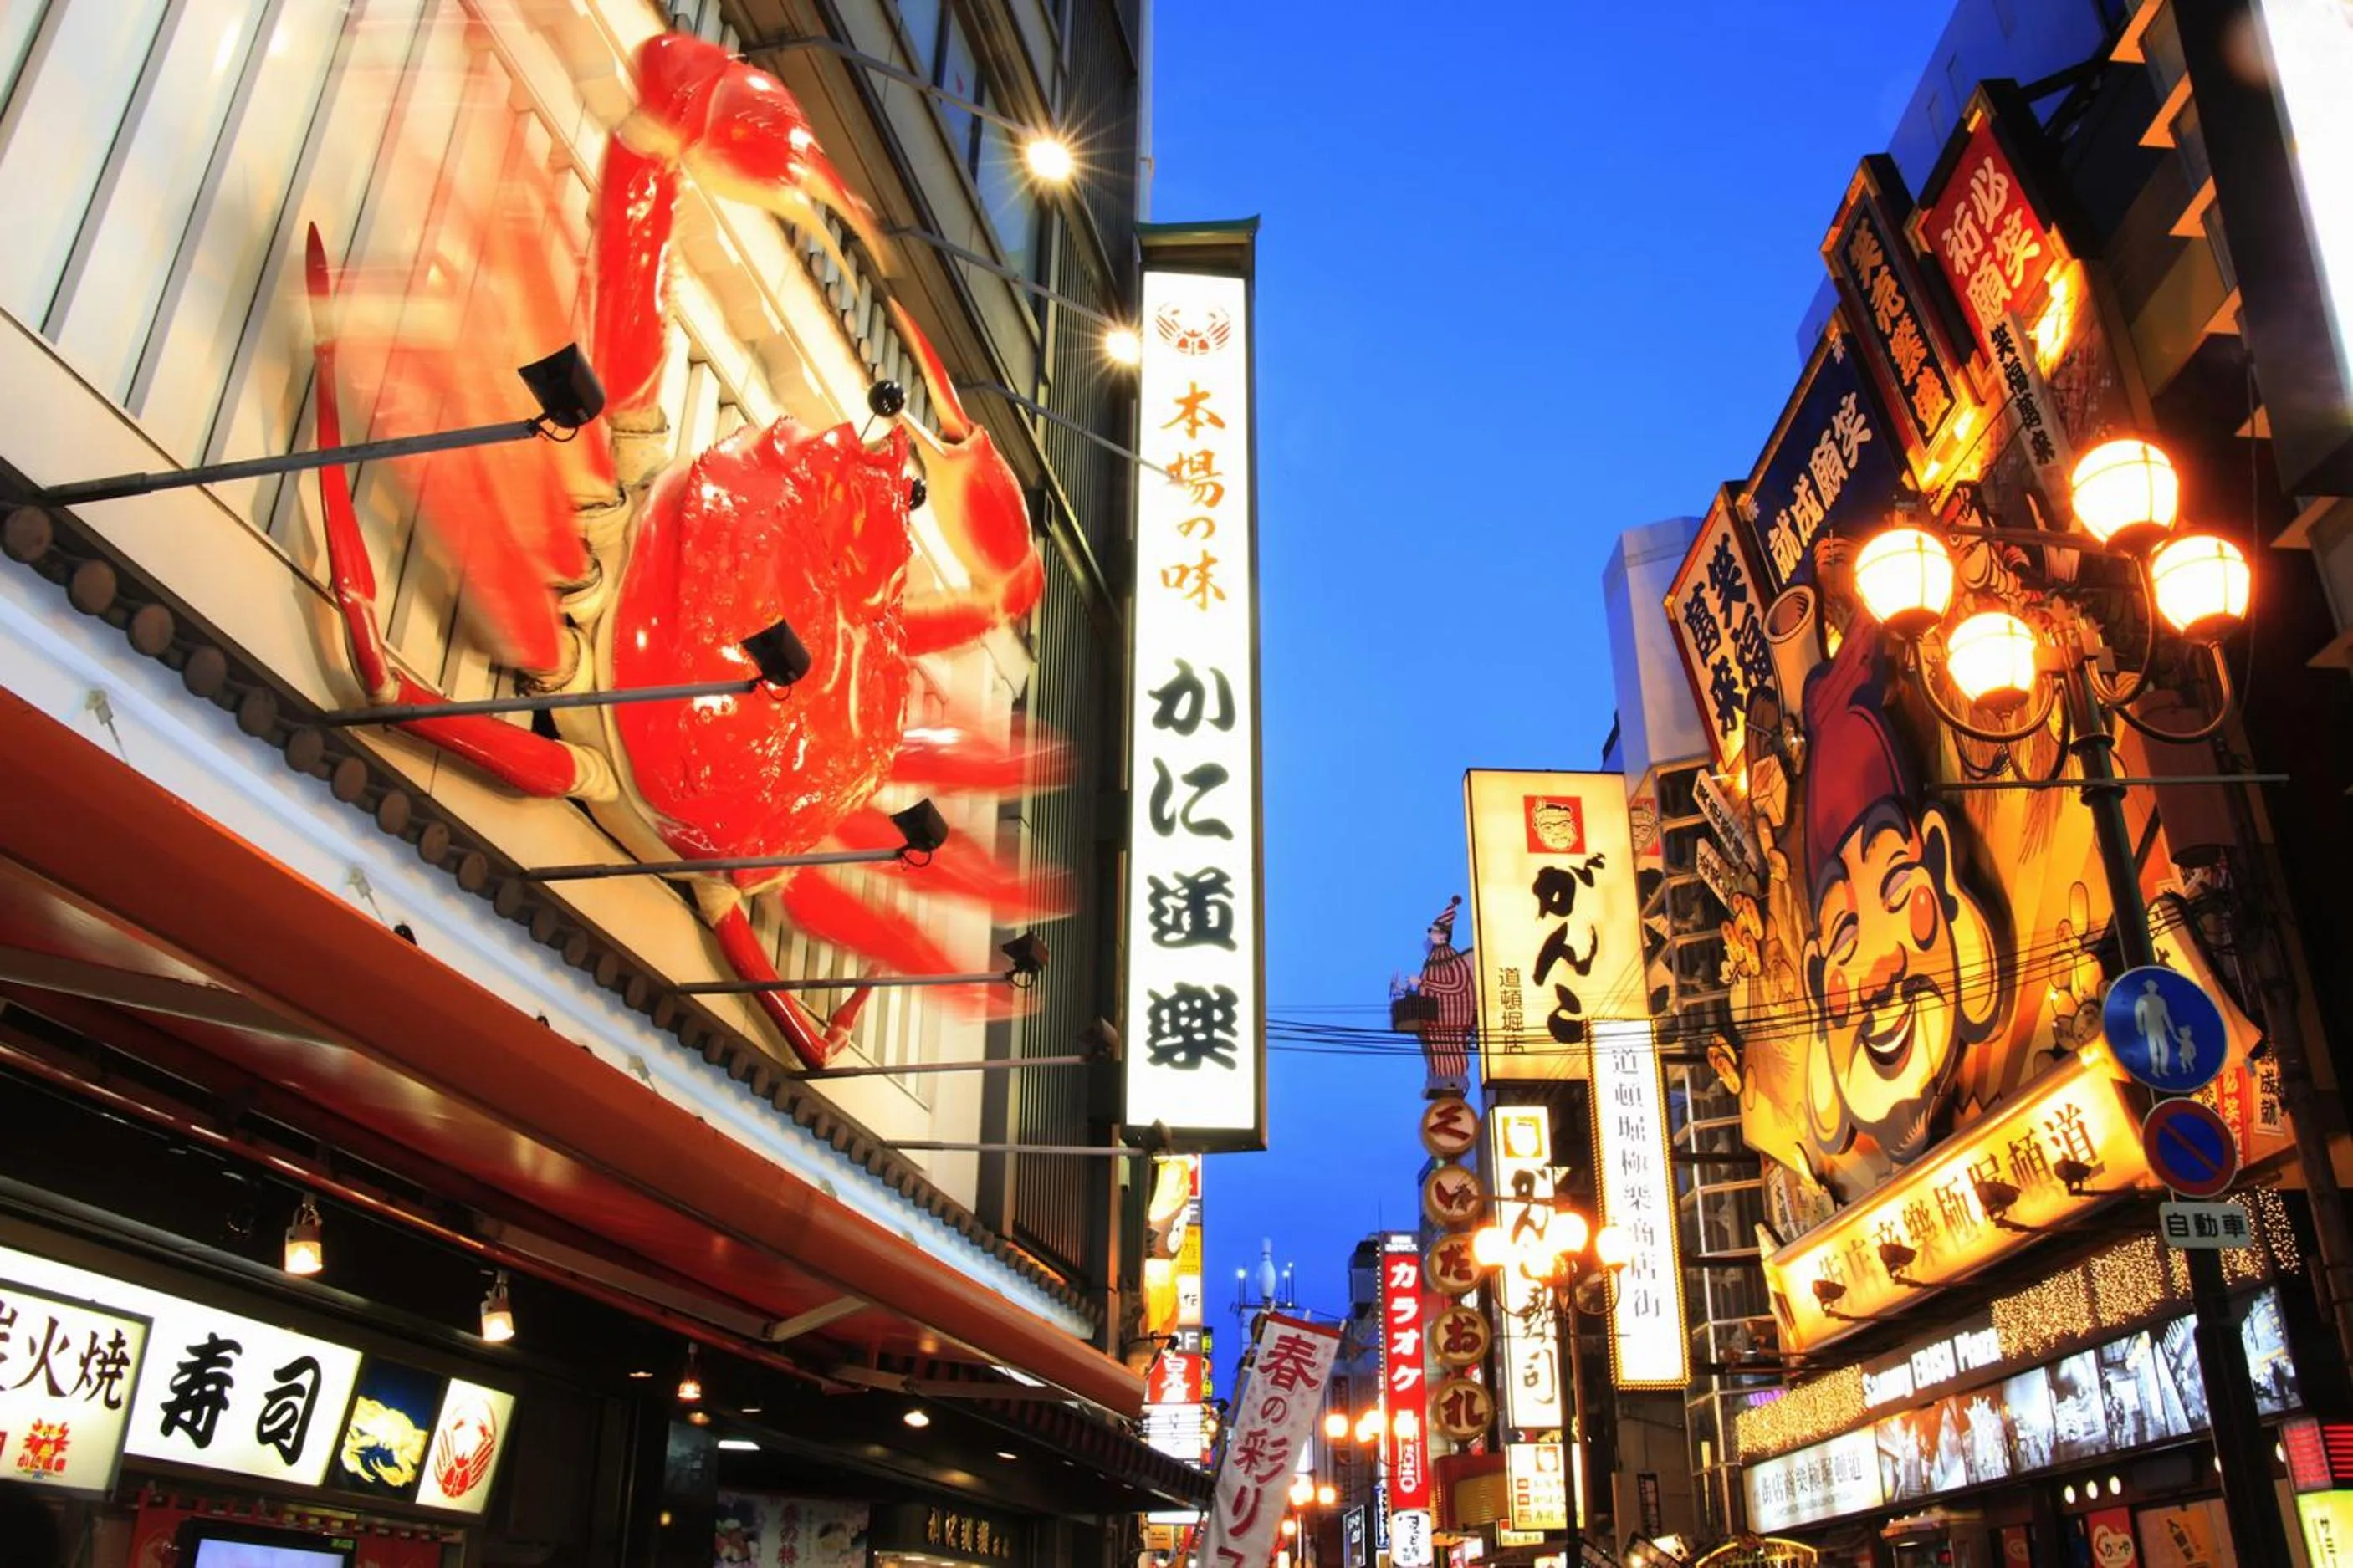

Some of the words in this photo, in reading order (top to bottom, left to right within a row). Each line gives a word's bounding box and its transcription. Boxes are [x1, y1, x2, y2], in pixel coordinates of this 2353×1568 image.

[1160, 381, 1226, 612] 本場の味
[1498, 967, 1525, 1055] 道頓堀店
[1531, 852, 1606, 1044] がんこ
[2166, 1213, 2248, 1239] 自動車
[1389, 1261, 1423, 1393] カラオケ
[160, 1332, 322, 1467] 寿司
